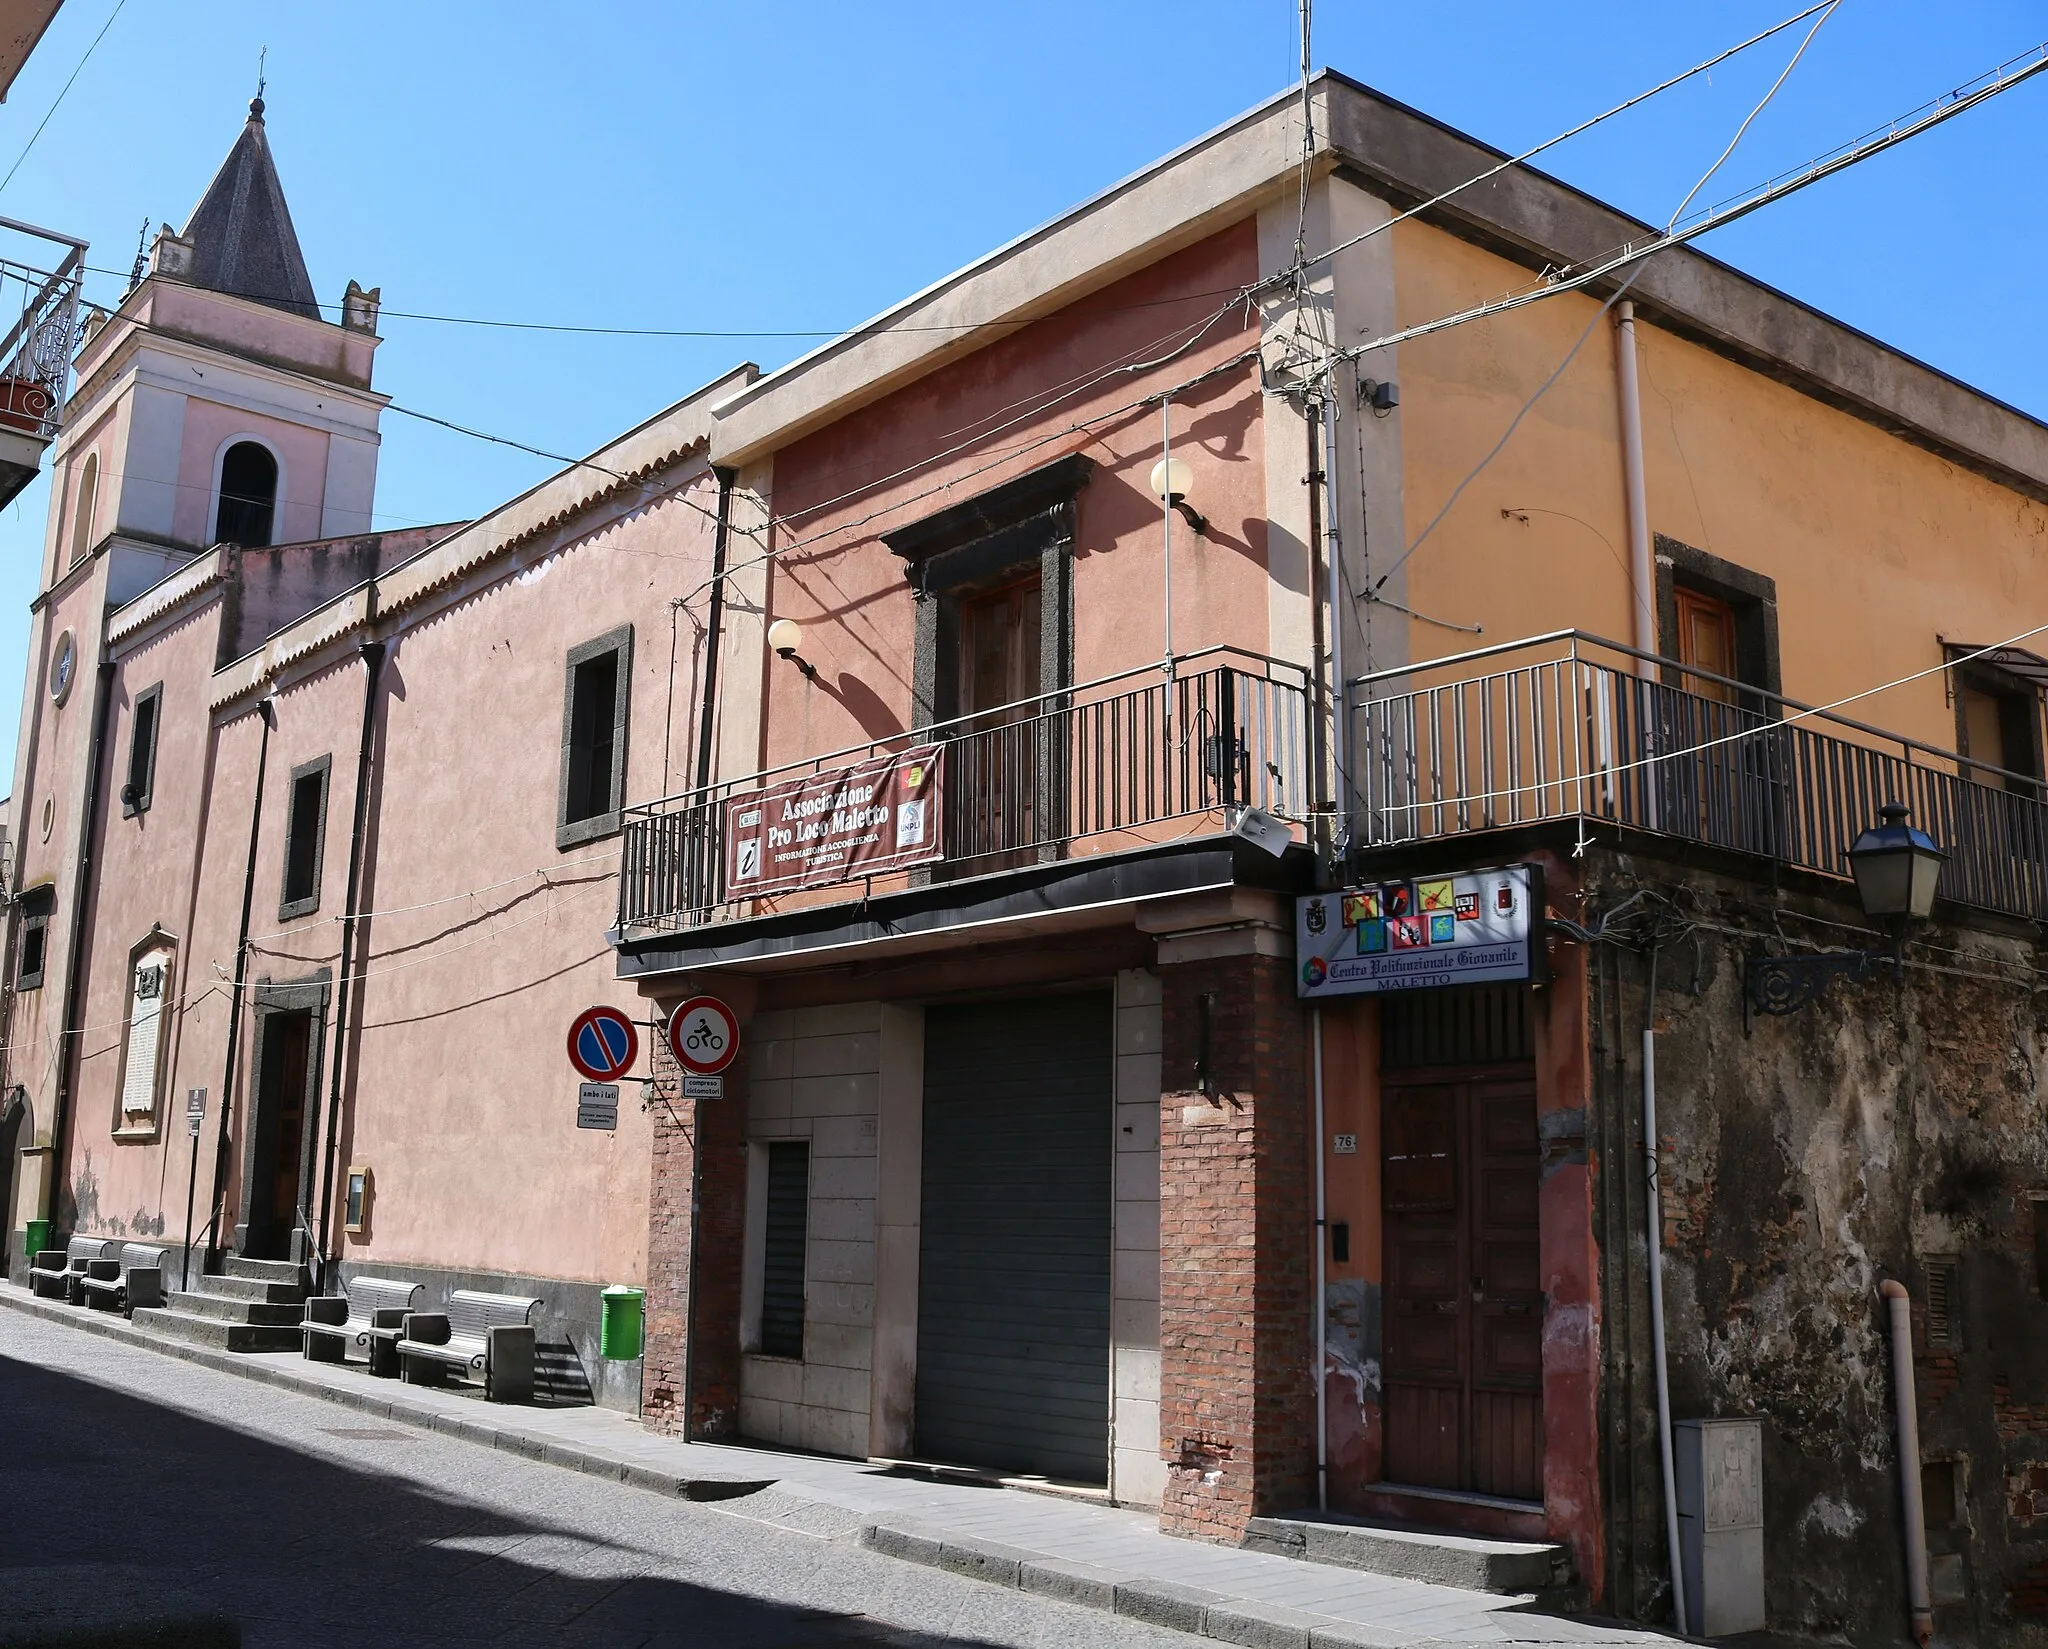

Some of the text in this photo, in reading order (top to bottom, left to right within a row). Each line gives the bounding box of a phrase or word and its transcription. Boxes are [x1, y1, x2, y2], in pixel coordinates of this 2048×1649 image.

[781, 785, 873, 821] Associazione
[767, 805, 889, 849] Pro Loco Maletto
[901, 821, 921, 832] UNPLI
[774, 844, 827, 863] INFORMAZIONE
[827, 833, 880, 851] ACCOGLIENZA
[806, 852, 844, 867] TURISTICA
[1329, 963, 1367, 979] Centro
[1370, 953, 1454, 979] Polifunzionale
[1457, 949, 1518, 967] Giovanile
[1377, 974, 1451, 990] MALETTO
[583, 1090, 600, 1098] ambo
[605, 1091, 617, 1099] lati
[686, 1087, 720, 1095] ciclomotori
[1338, 1136, 1352, 1147] 76
